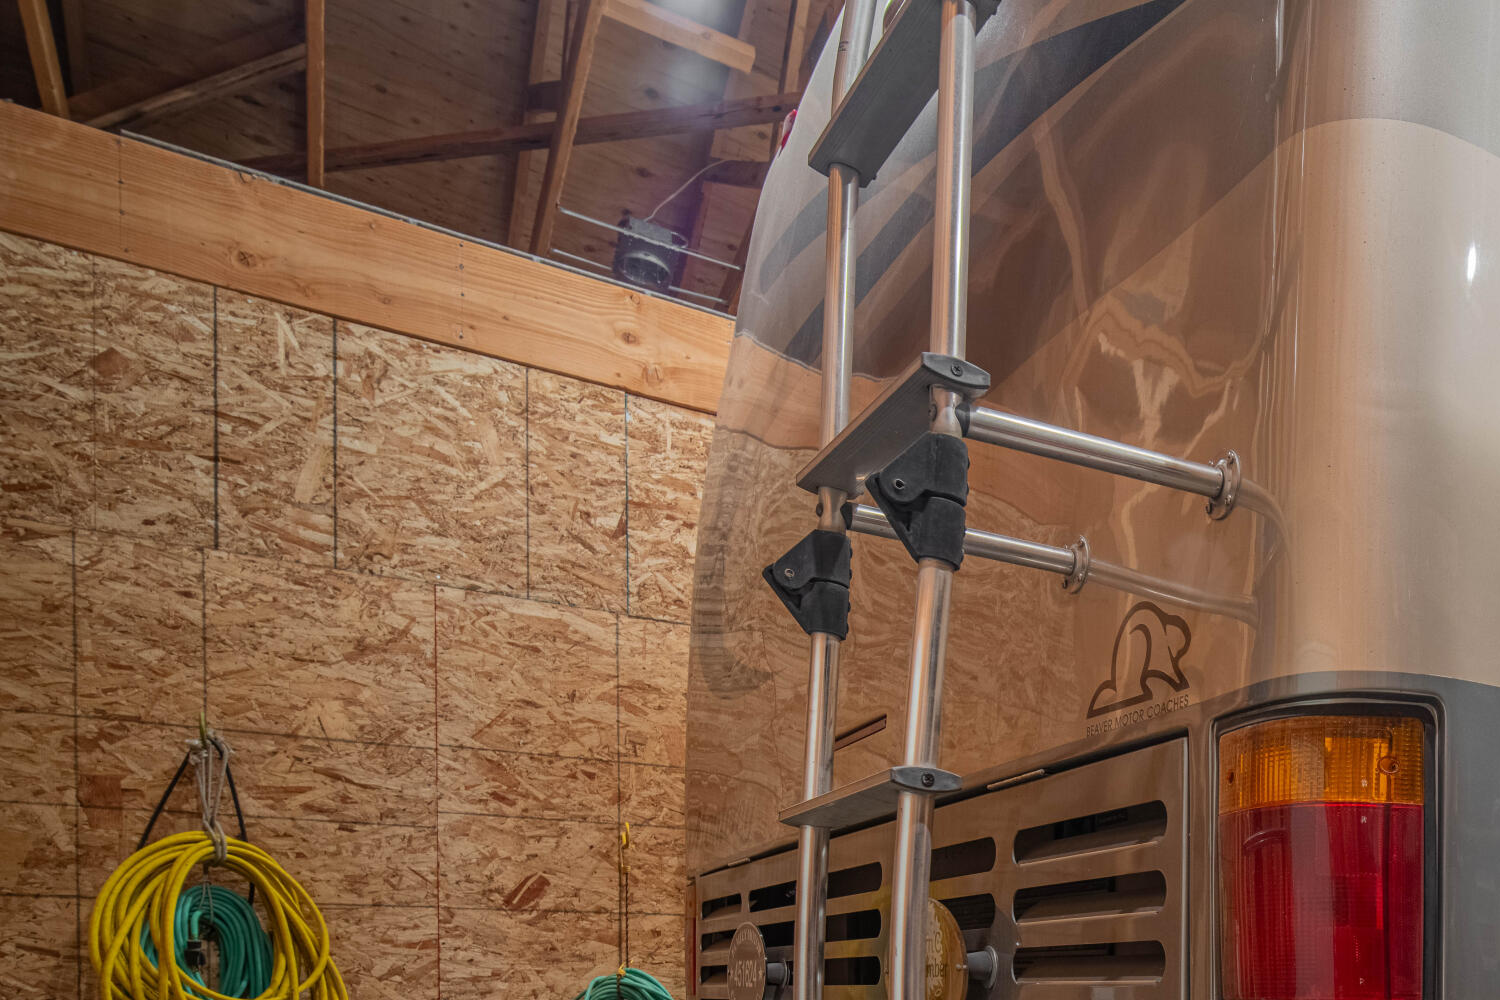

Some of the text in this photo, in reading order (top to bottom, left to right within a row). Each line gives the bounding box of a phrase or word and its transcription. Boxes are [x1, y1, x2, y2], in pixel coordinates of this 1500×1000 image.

[1086, 694, 1189, 738] BEAVER MOTOR COACHES
[734, 959, 757, 988] 451624
